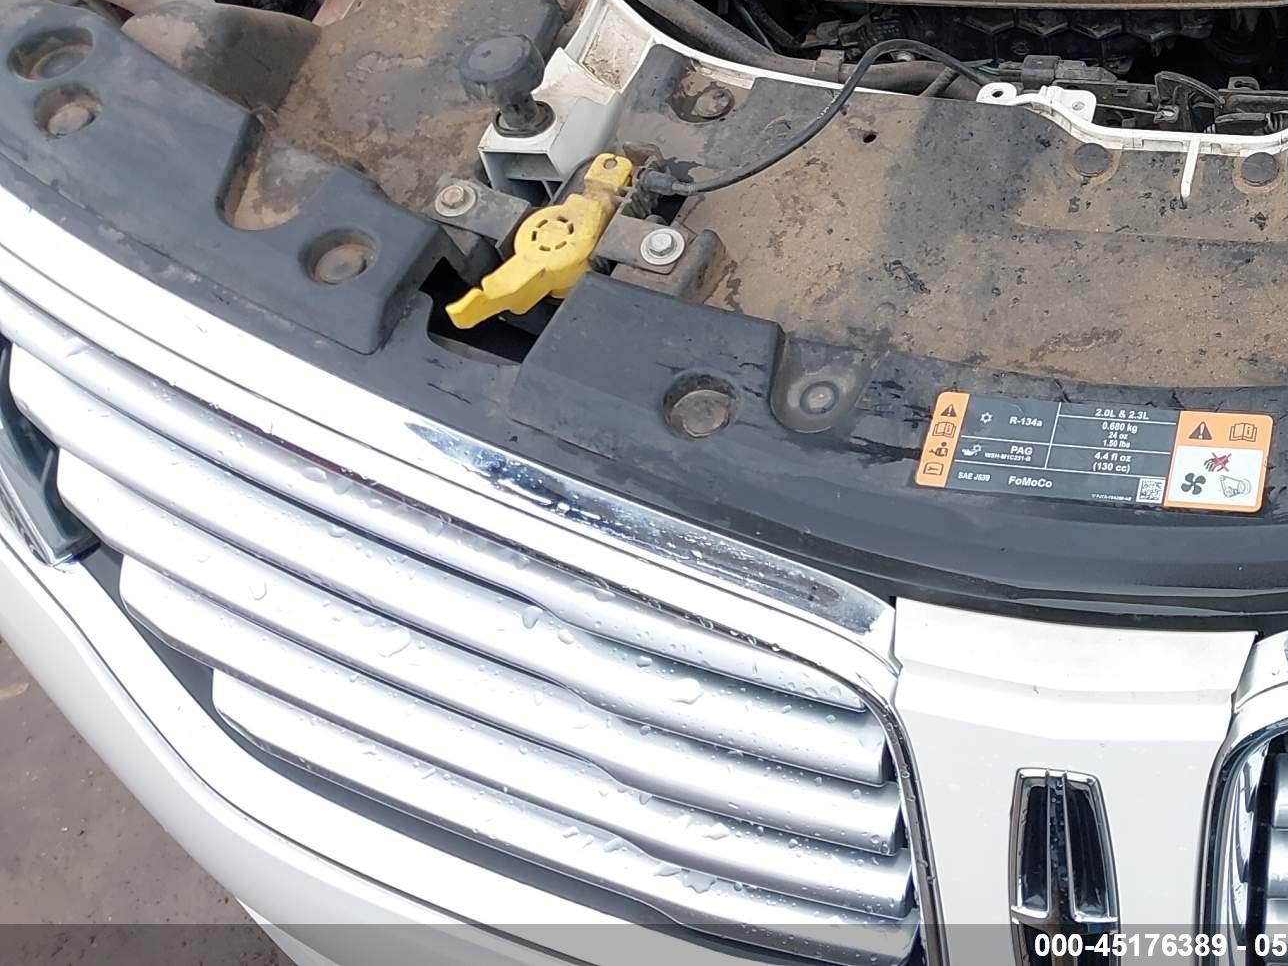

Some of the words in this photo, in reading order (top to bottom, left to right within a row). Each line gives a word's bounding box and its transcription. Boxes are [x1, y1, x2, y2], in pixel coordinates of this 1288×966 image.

[1095, 408, 1115, 418] 2.0L
[1118, 410, 1126, 418] &
[1130, 410, 1149, 420] 2.3L
[1009, 416, 1043, 427] R-134a
[1102, 421, 1126, 432] 0.680
[1126, 423, 1138, 433] kg
[1010, 445, 1033, 456] PAG
[1094, 451, 1109, 461] 4.4
[1110, 452, 1118, 462] fl
[1119, 454, 1131, 462] oz
[1092, 461, 1114, 472] (130
[1115, 463, 1131, 474] cc)
[958, 471, 973, 480] SAE
[1008, 475, 1053, 488] FoMoCo
